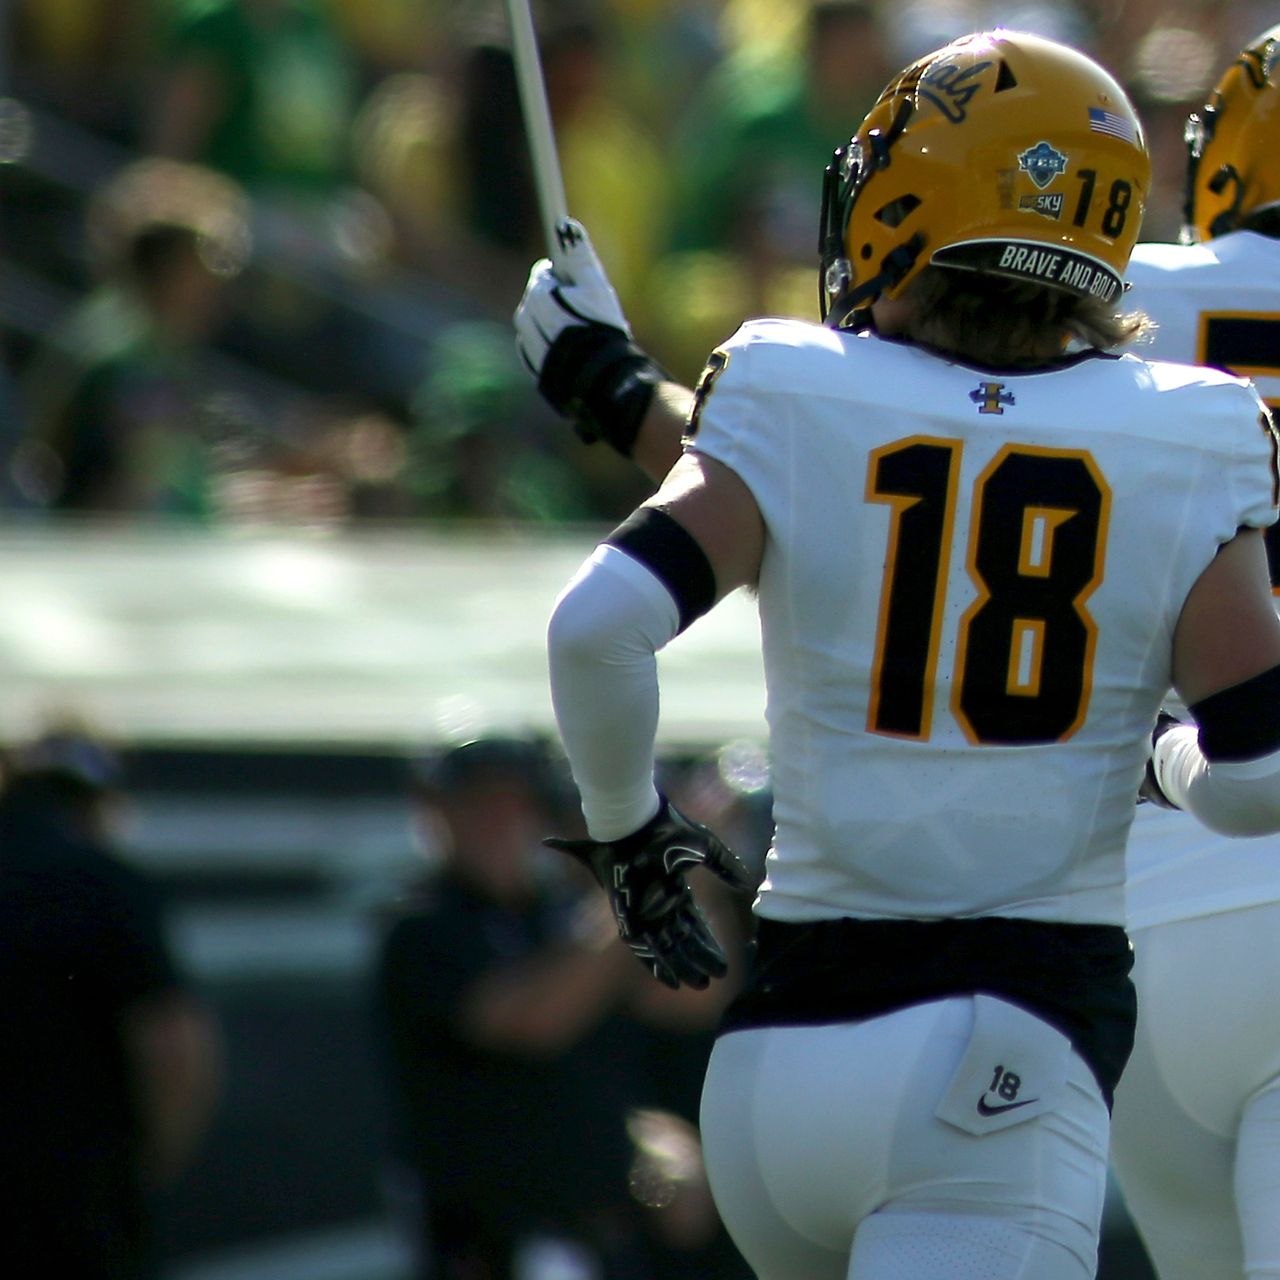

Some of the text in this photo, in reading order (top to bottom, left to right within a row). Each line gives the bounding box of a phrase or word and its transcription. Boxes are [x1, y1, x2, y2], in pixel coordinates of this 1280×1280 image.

[1072, 168, 1131, 240] 18
[999, 245, 1117, 302] BRAVE AND BOLD
[863, 433, 1113, 747] 18
[989, 1064, 1021, 1102] 18
